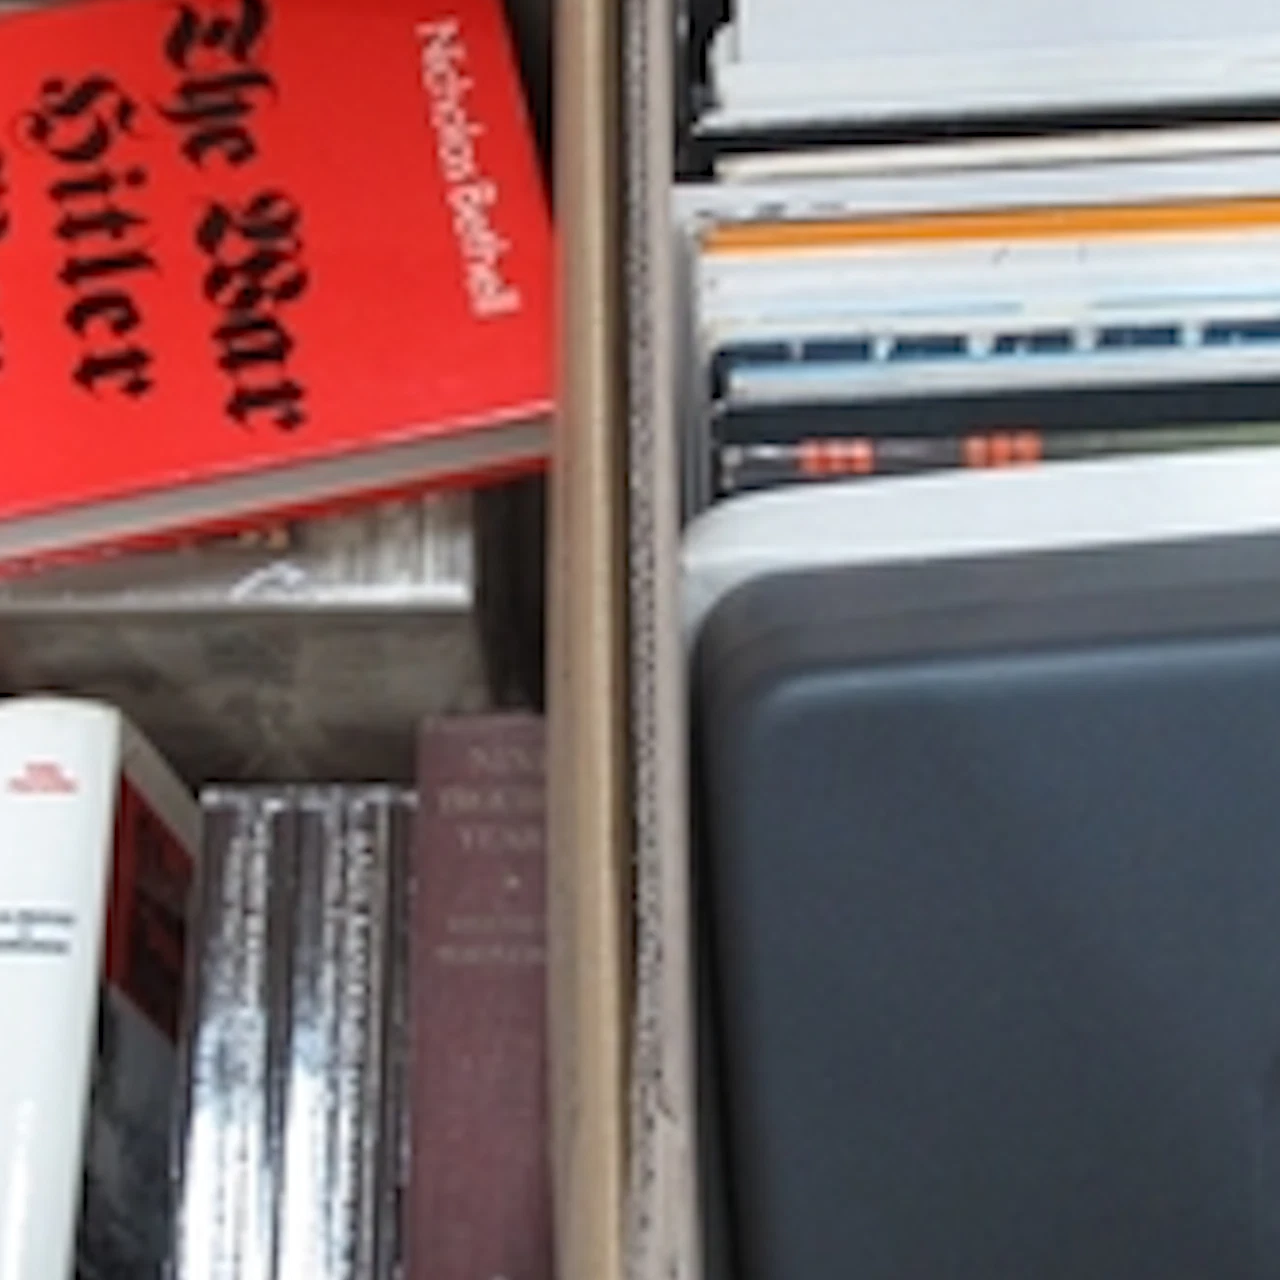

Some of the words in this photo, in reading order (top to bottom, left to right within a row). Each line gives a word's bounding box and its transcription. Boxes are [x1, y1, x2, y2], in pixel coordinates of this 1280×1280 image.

[415, 15, 487, 185] Nicholas
[25, 73, 162, 401] Hitler
[194, 187, 309, 434] War
[446, 180, 522, 319] Bethell
